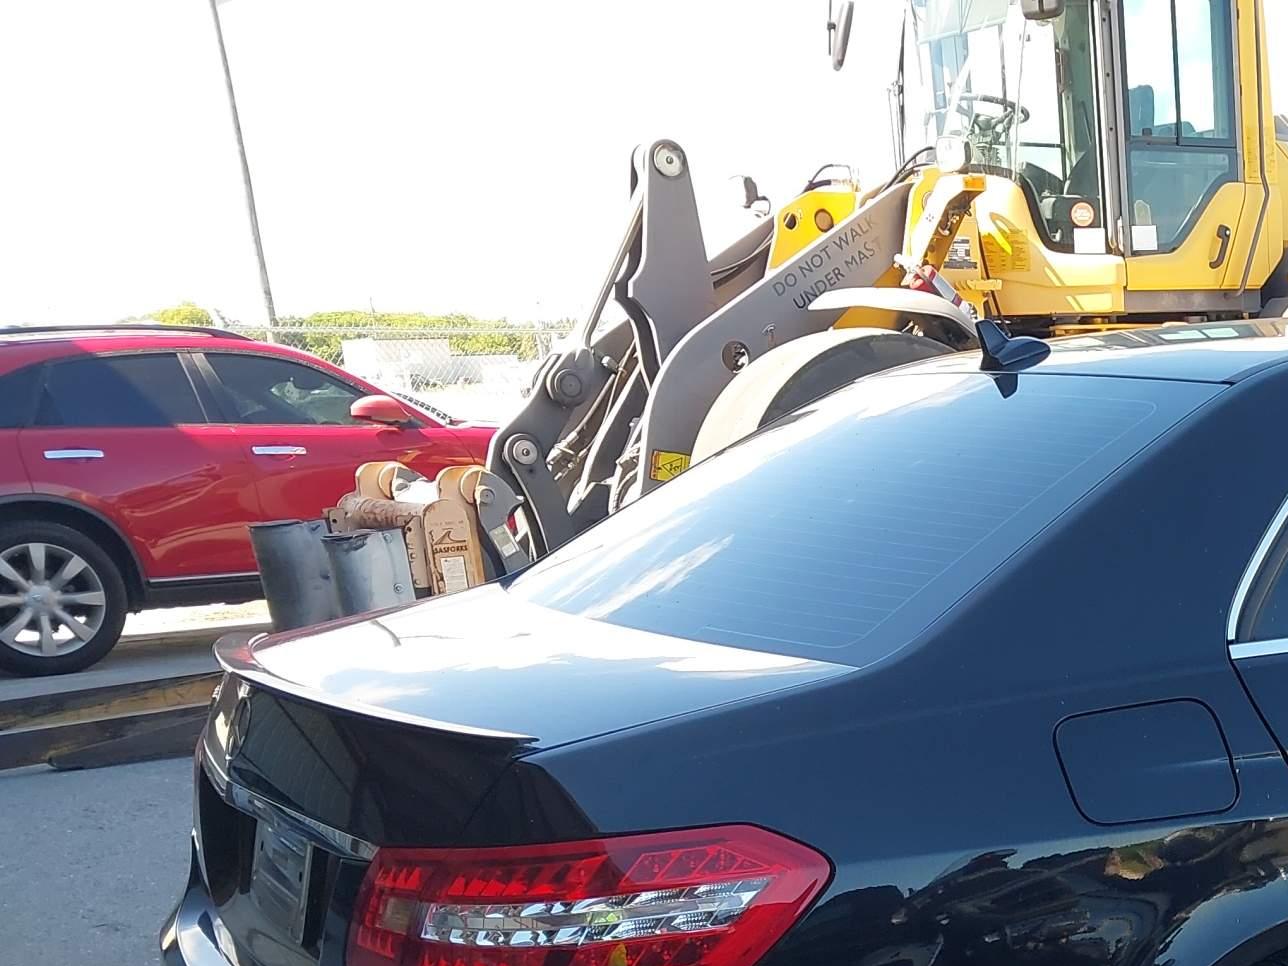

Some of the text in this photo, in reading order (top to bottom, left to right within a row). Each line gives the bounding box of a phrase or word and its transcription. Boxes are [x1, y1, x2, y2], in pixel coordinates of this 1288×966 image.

[772, 214, 878, 297] DO NOT WALK
[792, 236, 882, 309] UNDER MAST
